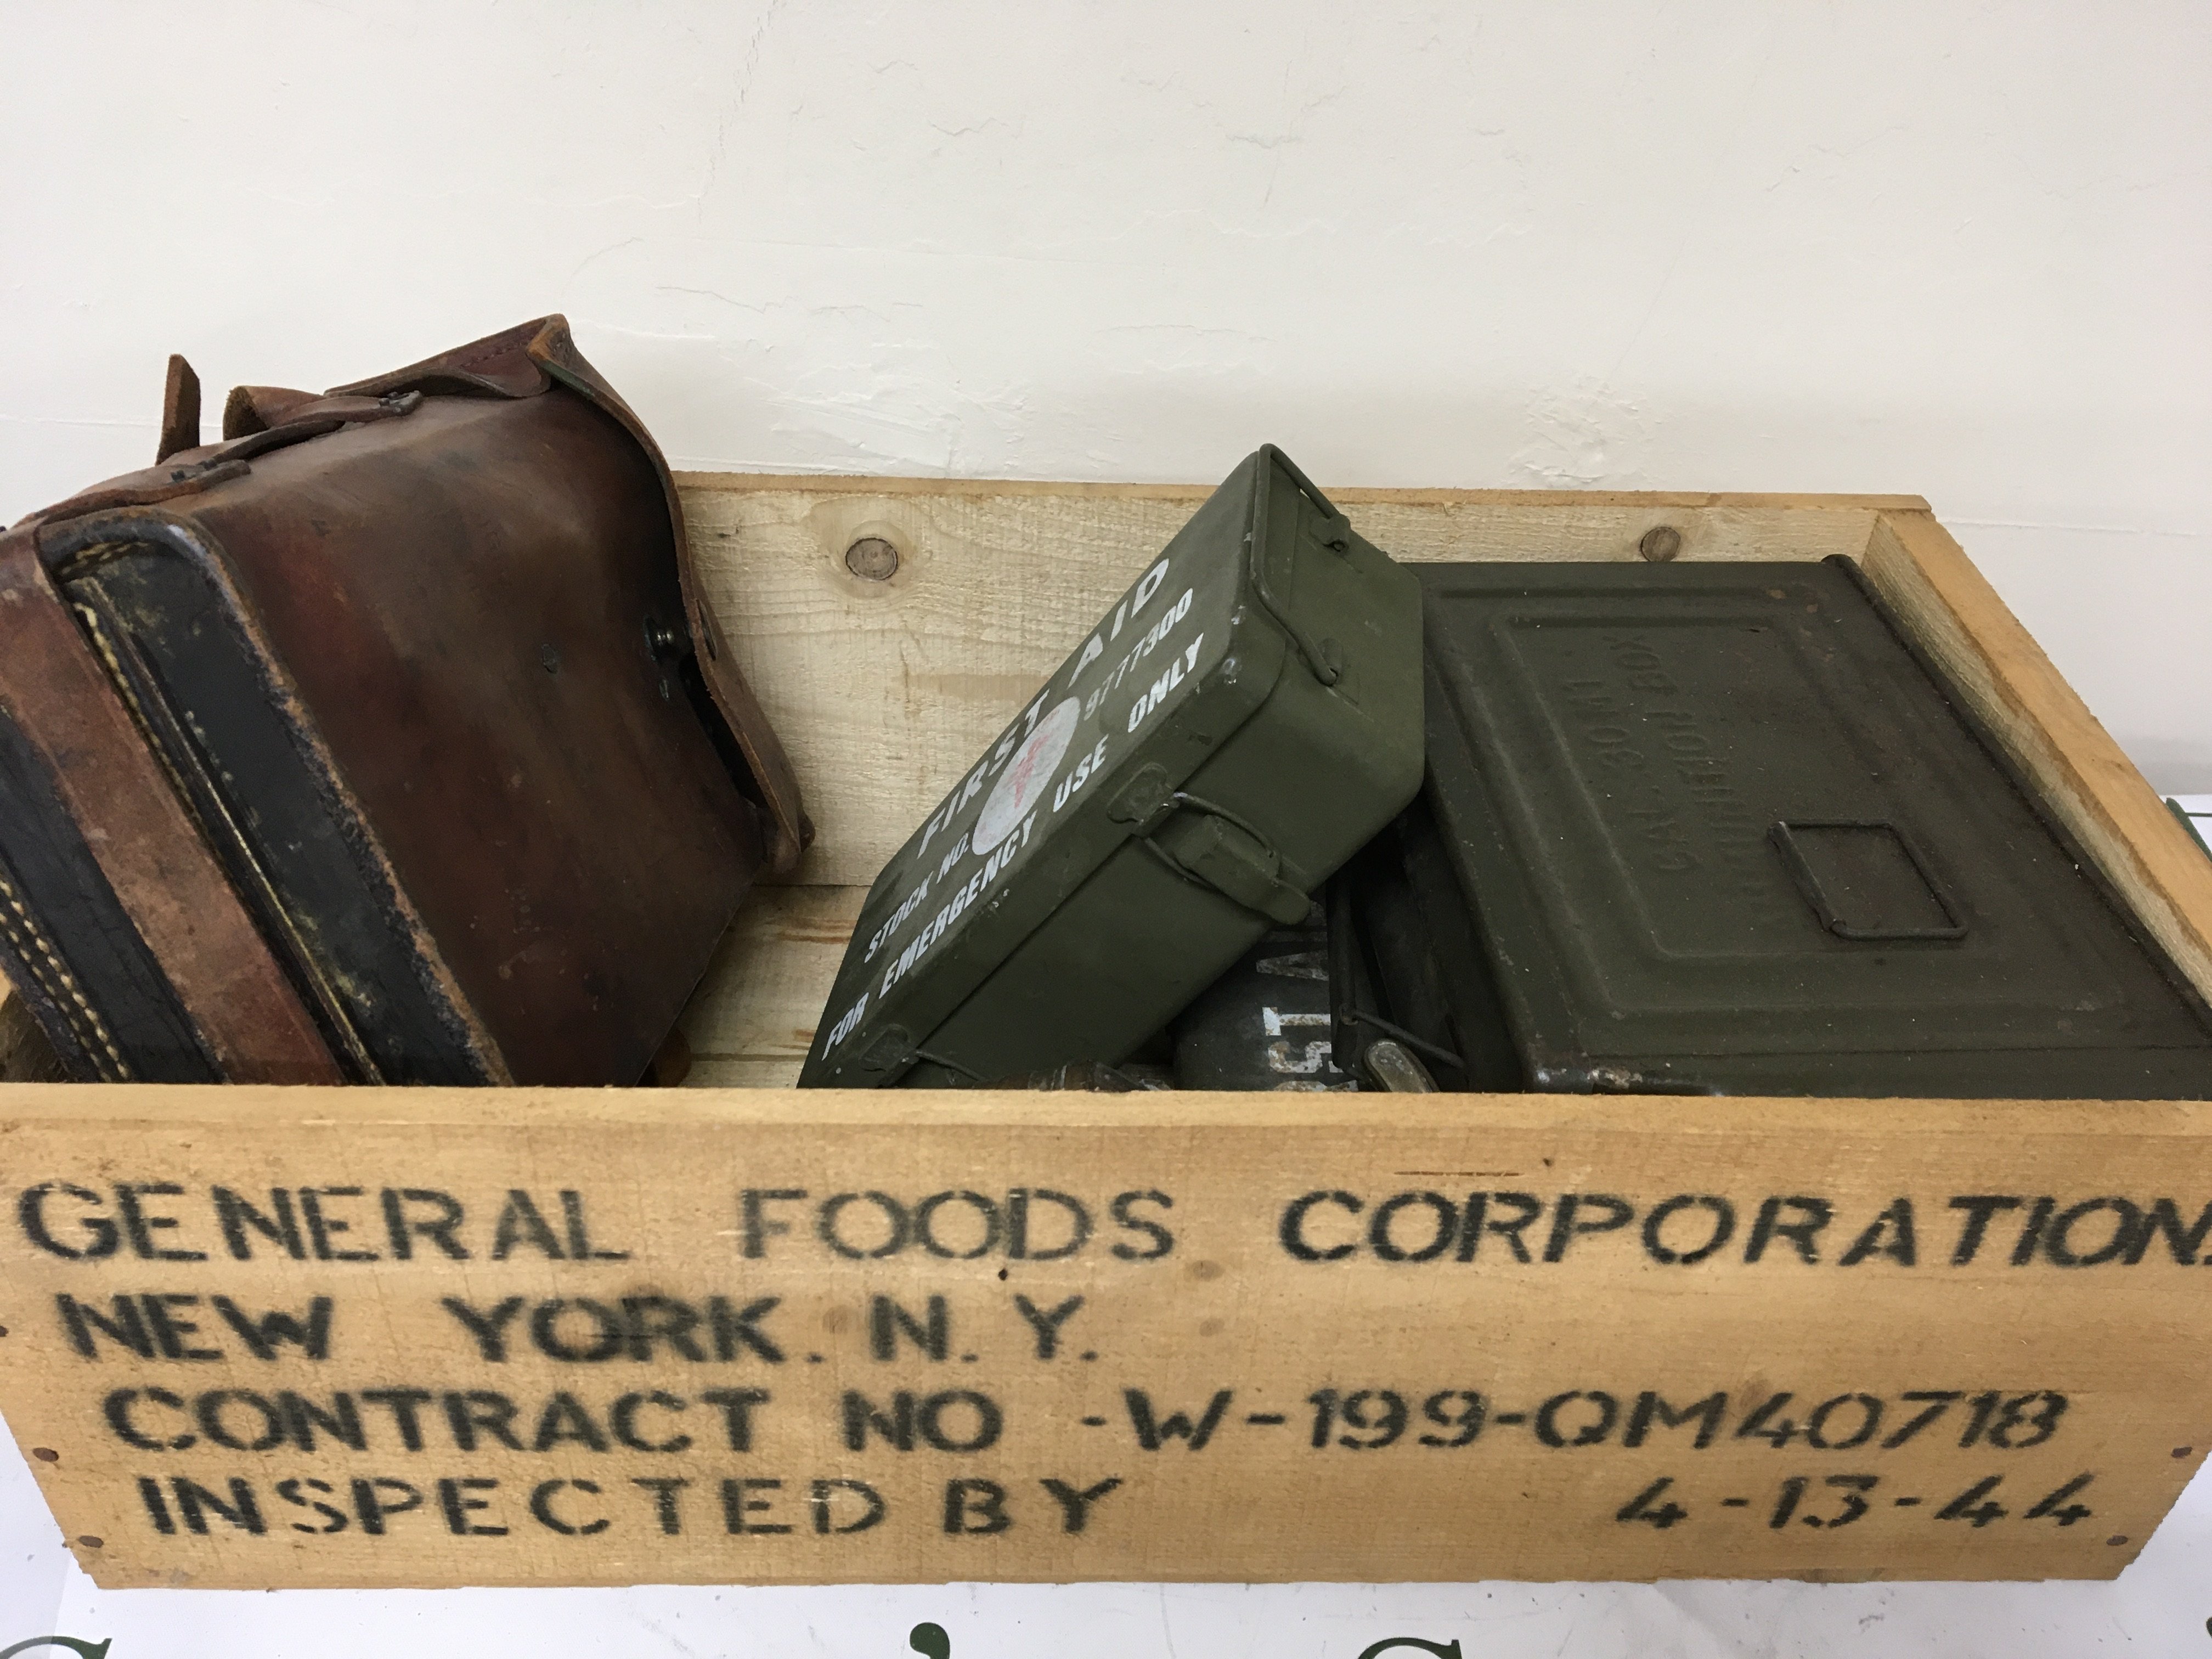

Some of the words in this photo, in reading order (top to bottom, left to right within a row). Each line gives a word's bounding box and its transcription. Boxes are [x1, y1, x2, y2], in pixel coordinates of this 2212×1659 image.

[1599, 634, 1680, 693] BOX
[918, 689, 1050, 859] FIRST
[1066, 558, 1170, 690] AID
[822, 992, 869, 1061] FOR
[879, 809, 1038, 1000] EMERGENCY
[1053, 733, 1109, 813] USE
[1127, 632, 1204, 733] ONLY
[865, 870, 934, 963] STOCK
[936, 832, 969, 884] NO.
[19, 1181, 631, 1262] GENERAL
[740, 1187, 1176, 1261] FOODS
[54, 1293, 332, 1362] NEW
[103, 1386, 771, 1454] CONTRACT
[842, 1388, 1004, 1453] NO
[137, 1476, 887, 1536] INSPECTED
[943, 1476, 1122, 1536] BY
[1614, 1472, 2096, 1531] 4-13-44
